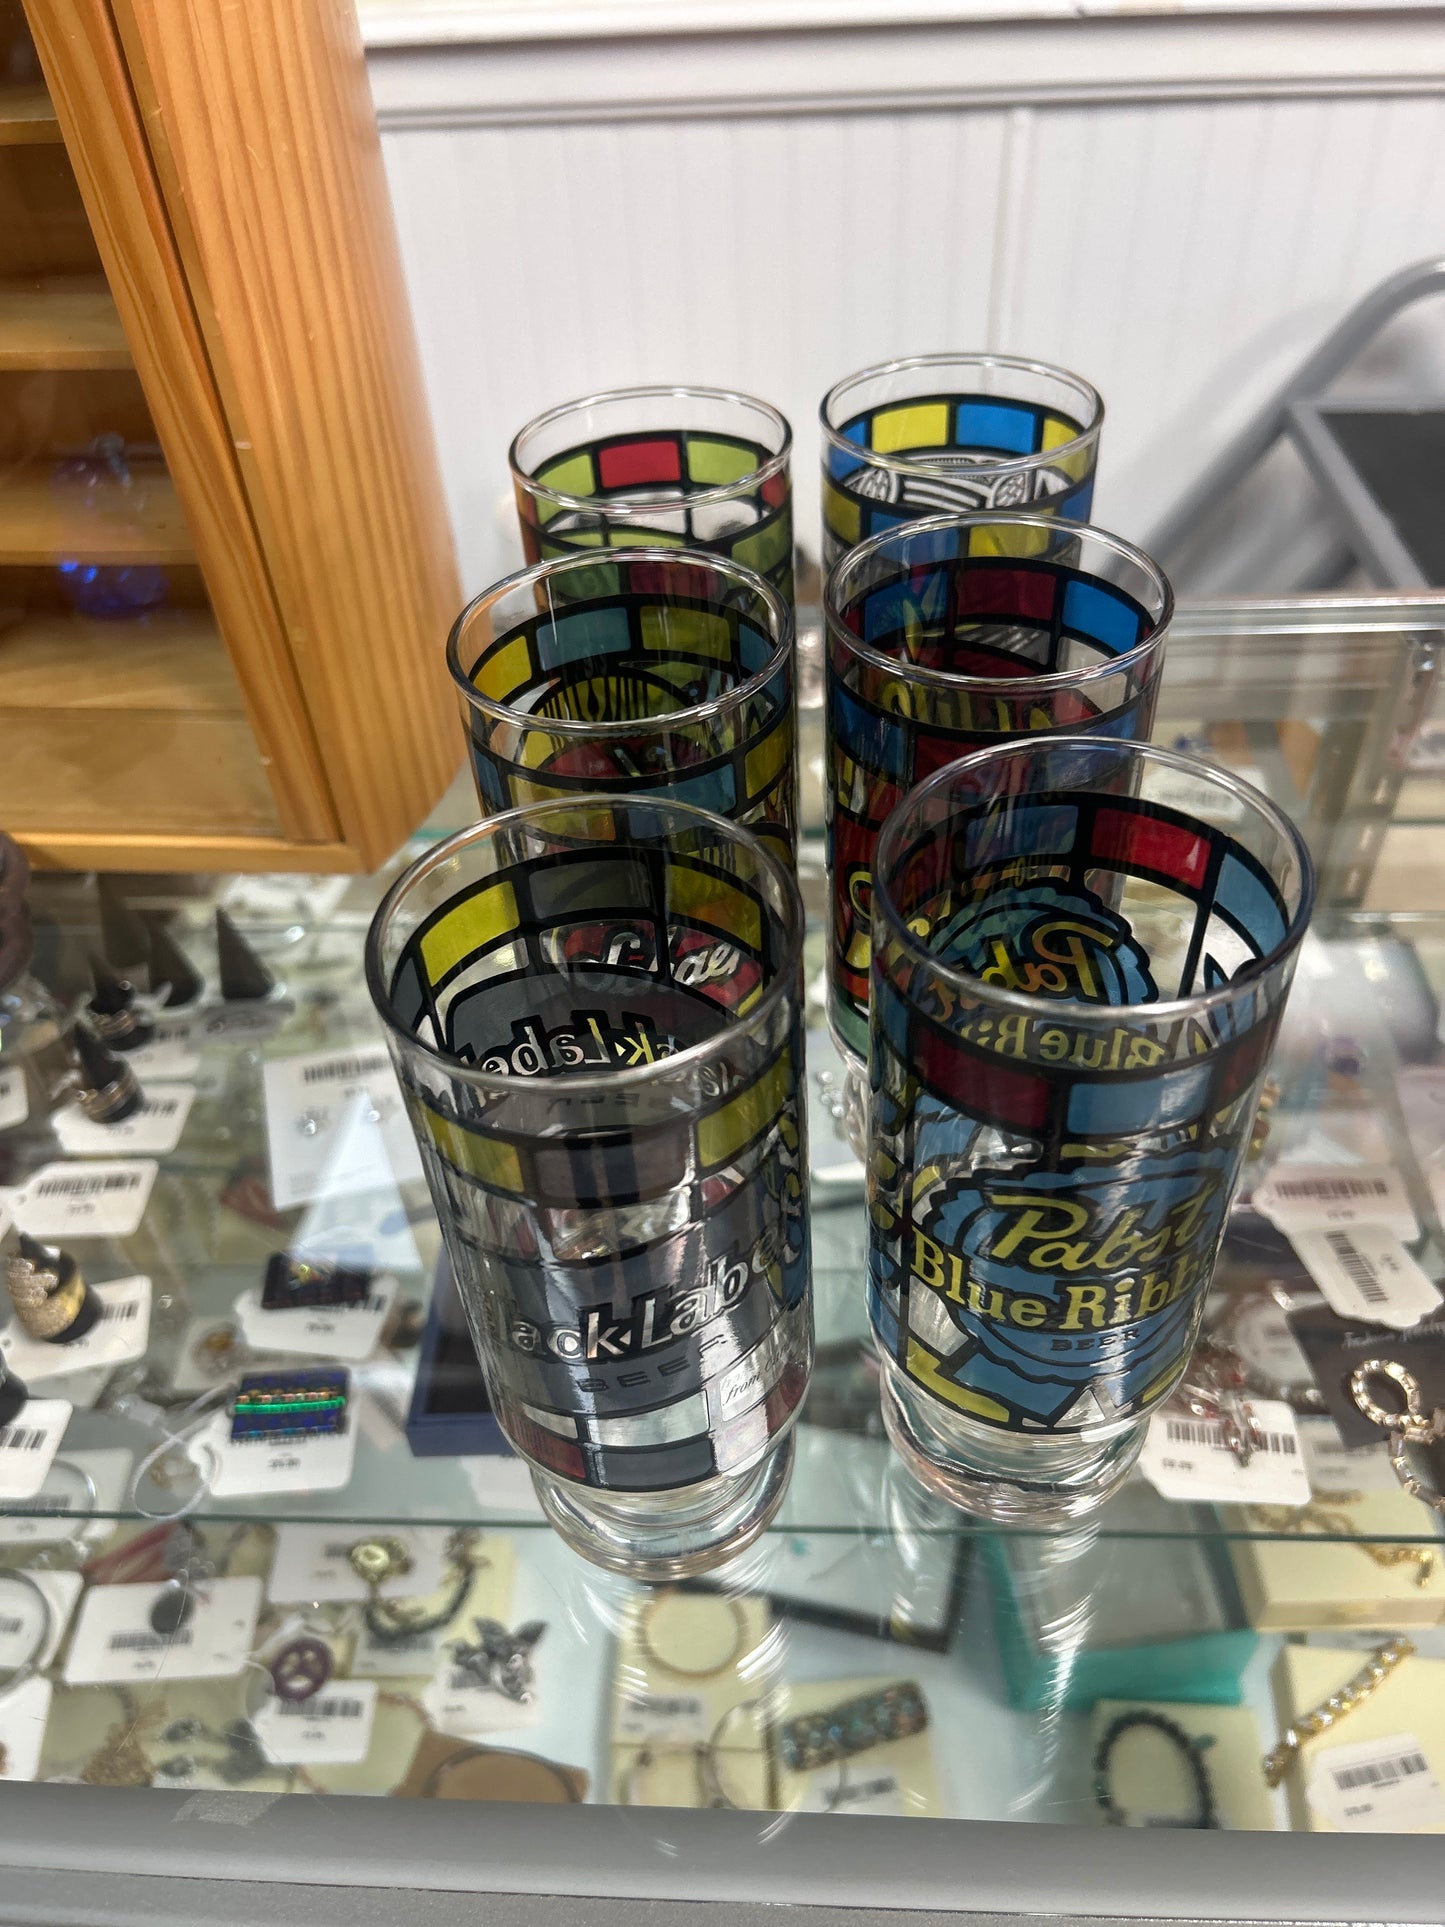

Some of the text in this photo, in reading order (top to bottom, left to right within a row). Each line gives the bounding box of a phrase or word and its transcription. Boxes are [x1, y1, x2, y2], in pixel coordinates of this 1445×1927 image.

[989, 1180, 1218, 1272] Pabst
[910, 1225, 1200, 1331] Blue Ribb
[1049, 1328, 1141, 1352] BEER
